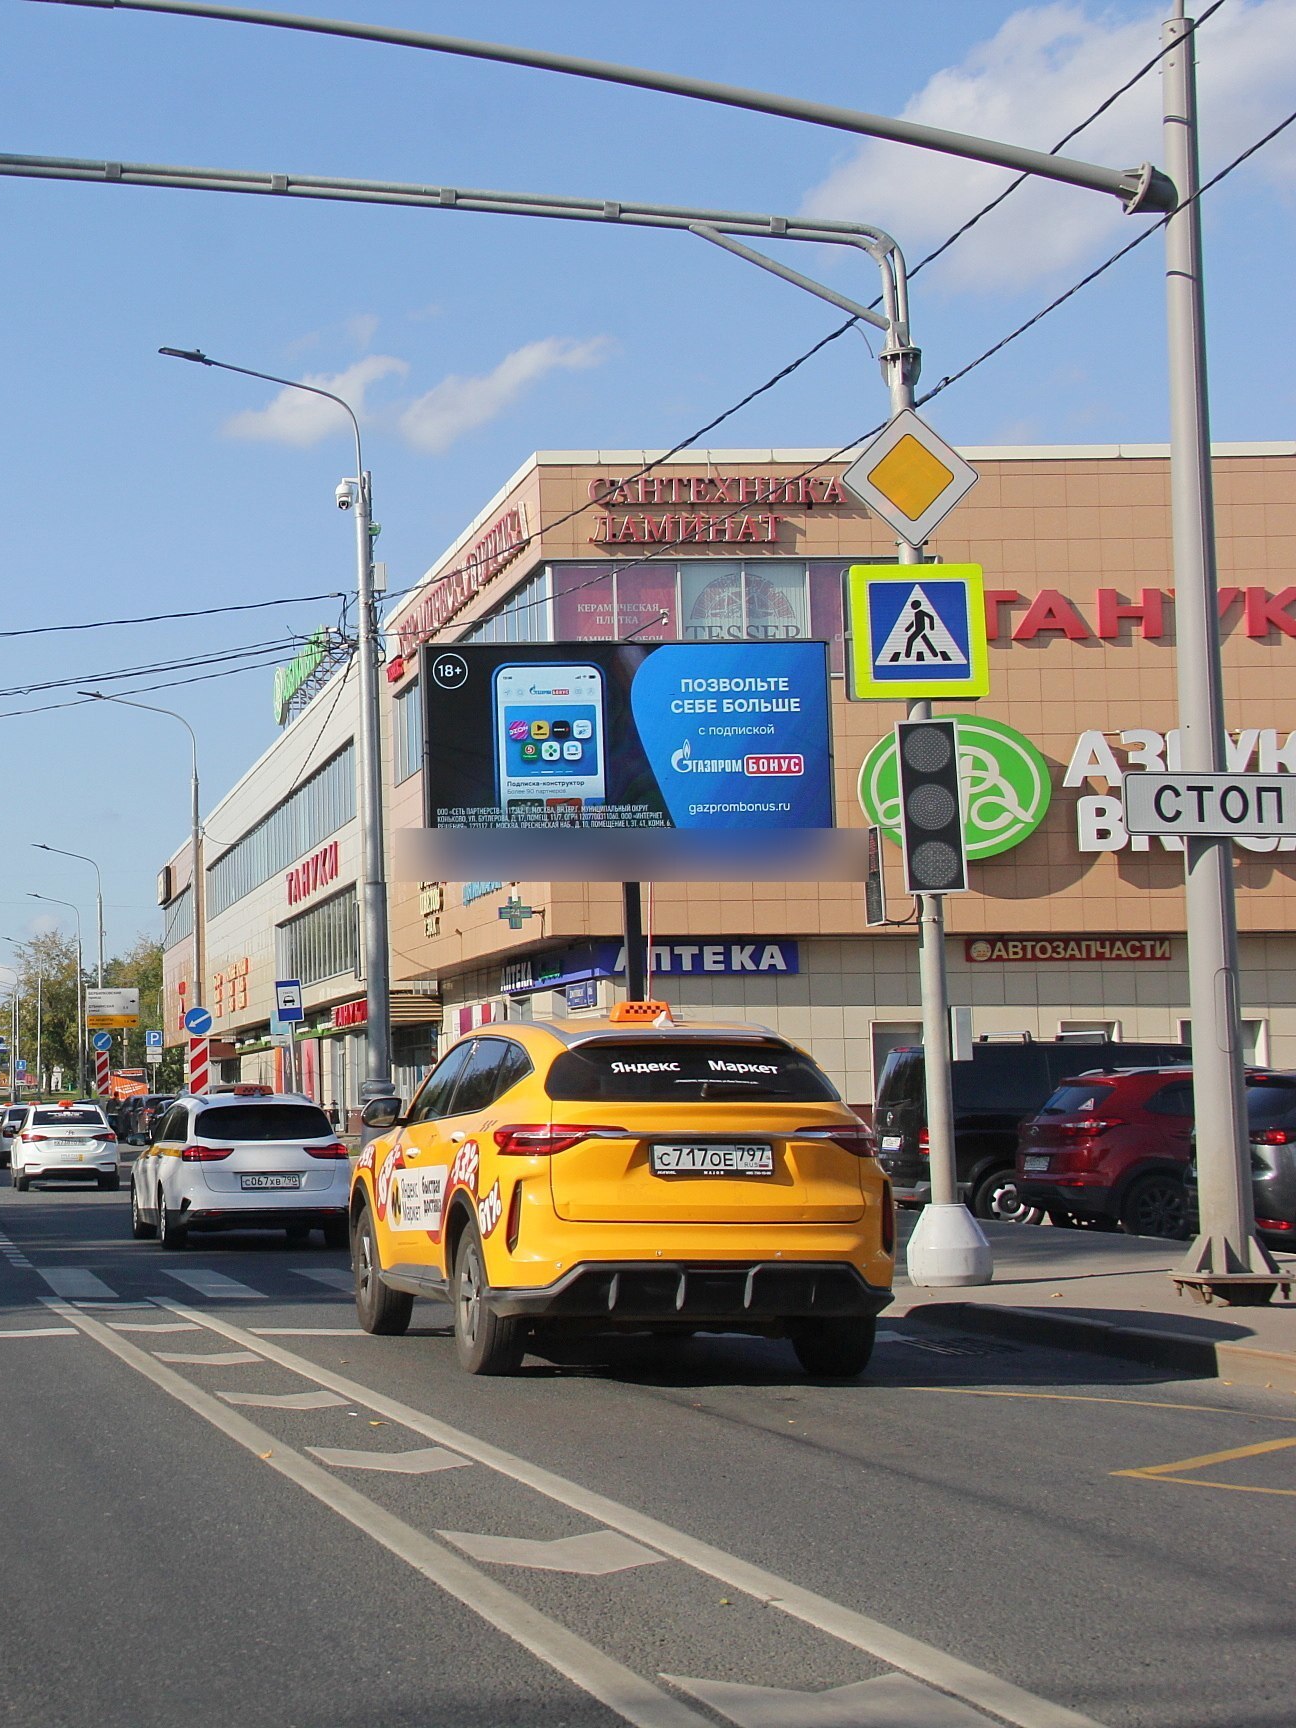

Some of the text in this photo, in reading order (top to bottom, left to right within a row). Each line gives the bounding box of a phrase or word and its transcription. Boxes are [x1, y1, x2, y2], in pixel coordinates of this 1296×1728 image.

[588, 476, 848, 504] САНТЕХНИКА
[588, 514, 784, 543] ЛАМИНАТ
[438, 665, 462, 677] 18+
[681, 678, 789, 693] ПОЗВОЛЬТЕ
[671, 698, 801, 713] СЕБЕ БОЛЬШЕ
[698, 724, 775, 737] с подпиской
[748, 758, 800, 772] БОНУС
[689, 801, 791, 815] gazprombonus.ru
[1154, 785, 1283, 824] СТОП
[286, 841, 339, 906] ТАНУКИ
[991, 940, 1170, 959] АВТОЗАПЧАСТИ
[611, 1060, 778, 1074] Яндекс Маркет
[660, 1147, 766, 1167] С717ОЕ 797
